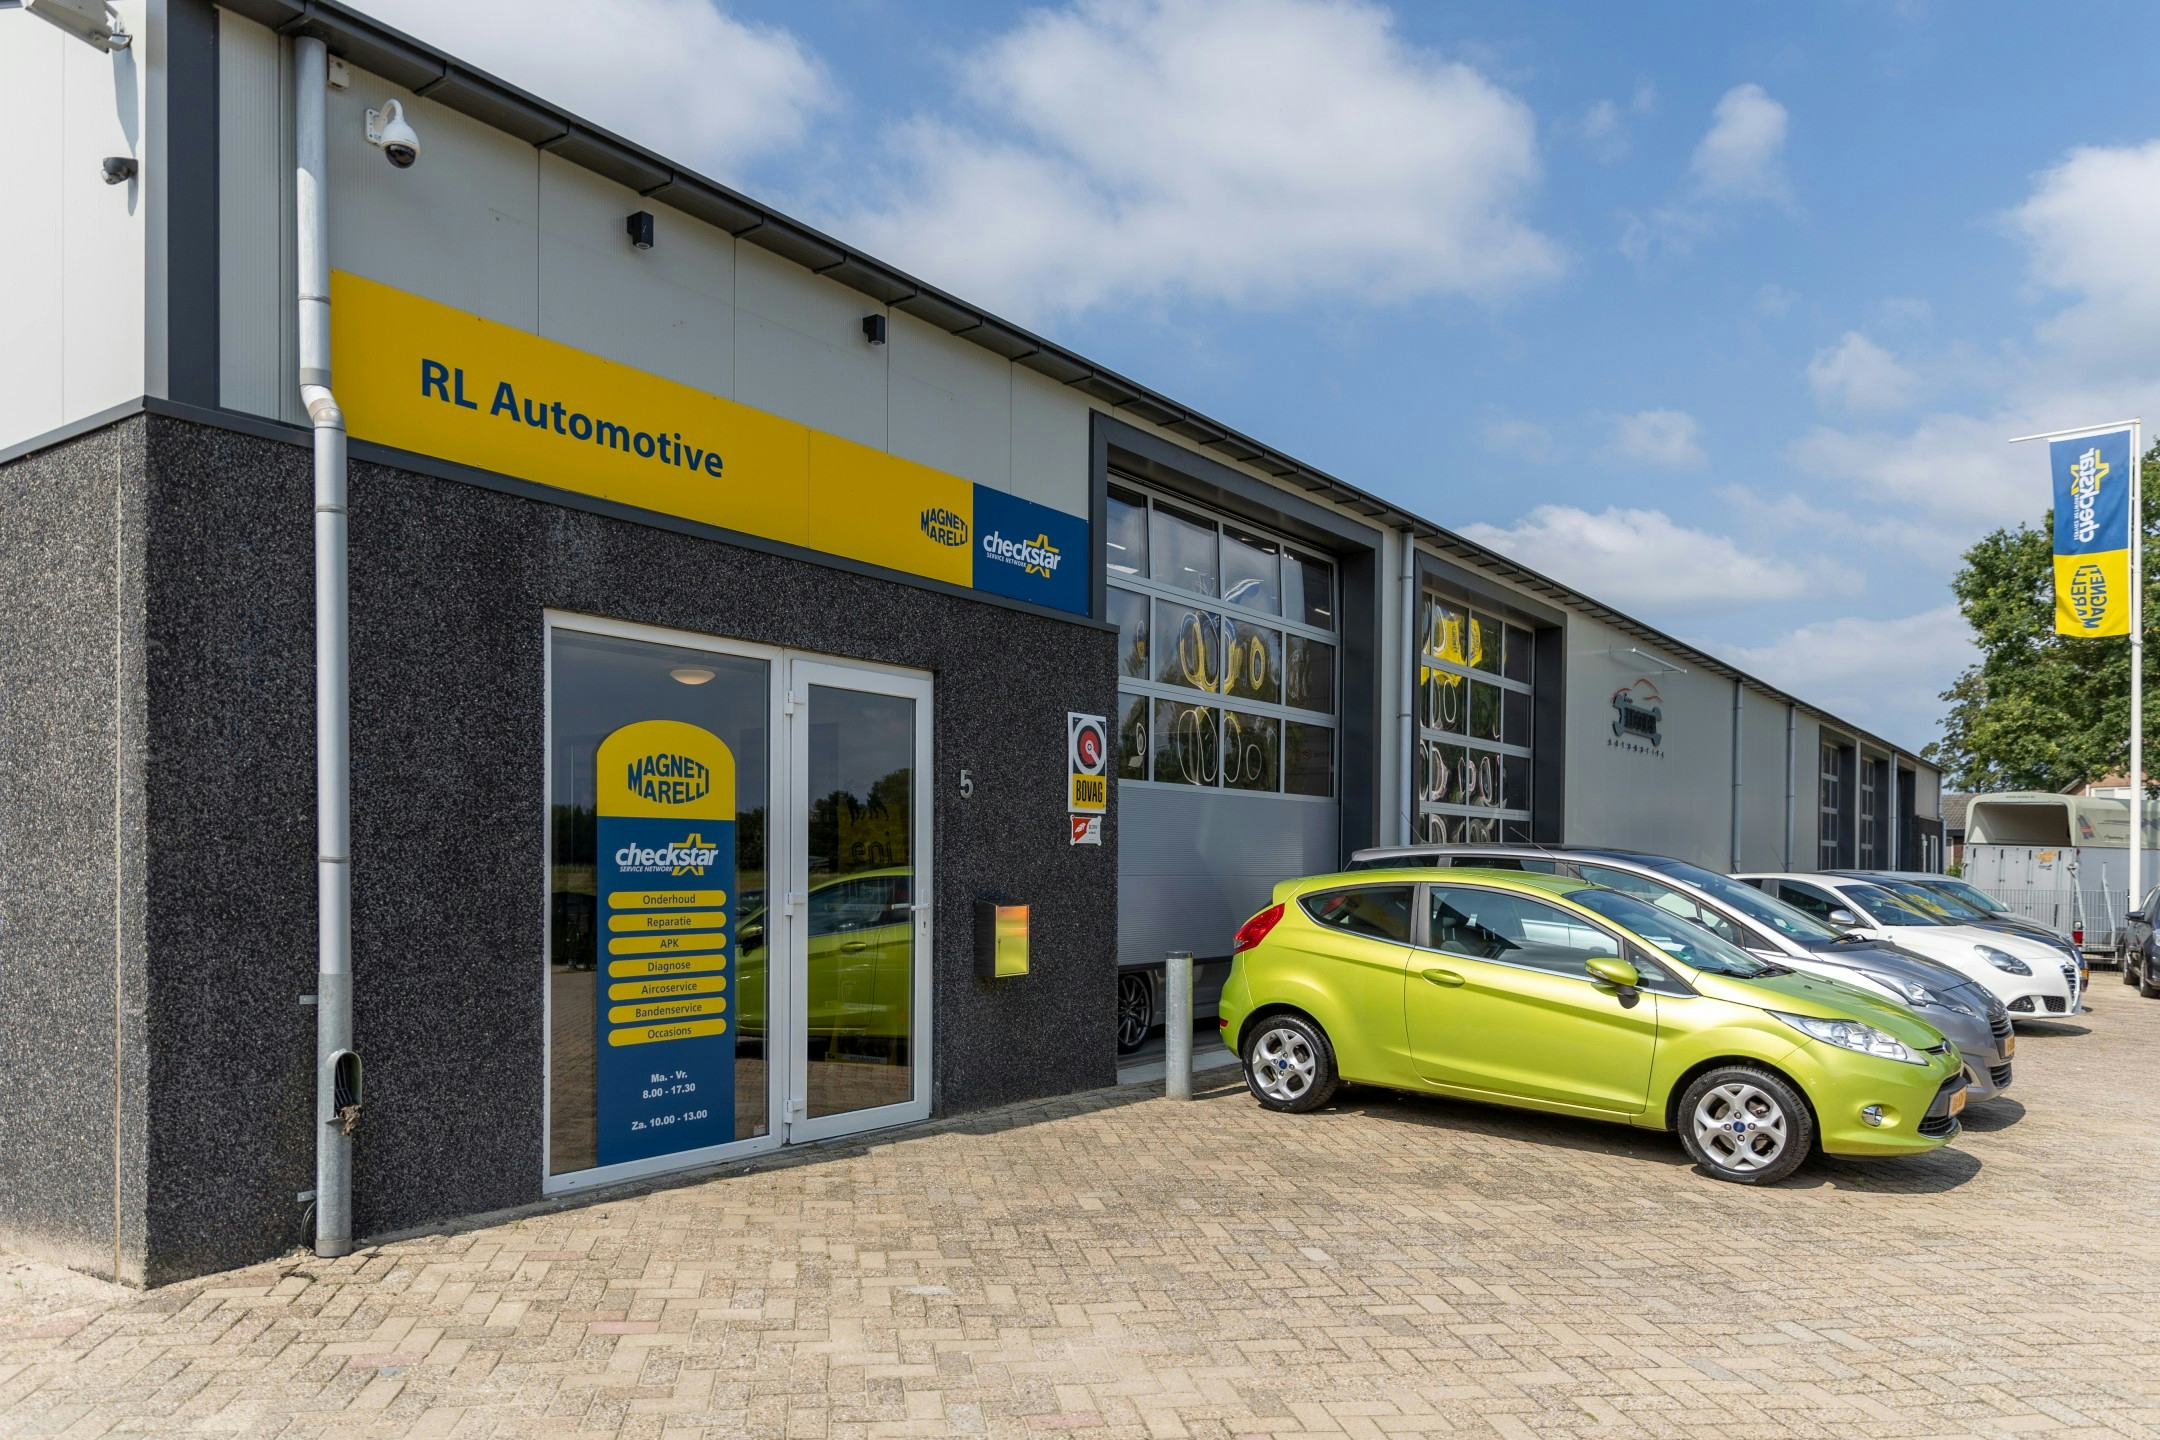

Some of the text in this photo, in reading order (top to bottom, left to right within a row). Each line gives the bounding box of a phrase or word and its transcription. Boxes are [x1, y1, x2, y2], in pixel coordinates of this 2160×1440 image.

[421, 358, 724, 478] RL Automotive
[921, 508, 968, 537] MAGNETI
[921, 518, 968, 547] MARELLI
[983, 531, 1061, 570] checkstar
[986, 552, 1027, 568] SERVICE NETWORK
[627, 753, 709, 787] MAGNETI
[627, 771, 709, 804] MARELLI
[960, 769, 974, 799] 5
[1076, 779, 1103, 803] BOVAG
[615, 842, 719, 866] checkstar
[642, 894, 696, 905] Onderhoud
[647, 916, 692, 928] Reparatie
[660, 939, 679, 949] APK
[647, 961, 691, 973] Diagnose
[641, 981, 698, 995] Aircoservice
[635, 1003, 703, 1018] Bandenservice
[647, 1026, 692, 1039] Occasions
[651, 1073, 668, 1083] Ma.
[675, 1070, 688, 1080] Vr.
[642, 1088, 663, 1099] 8.00
[670, 1083, 696, 1094] 17.30
[631, 1121, 647, 1131] Za.
[649, 1115, 675, 1127] 10.00
[683, 1109, 708, 1121] 13.00
